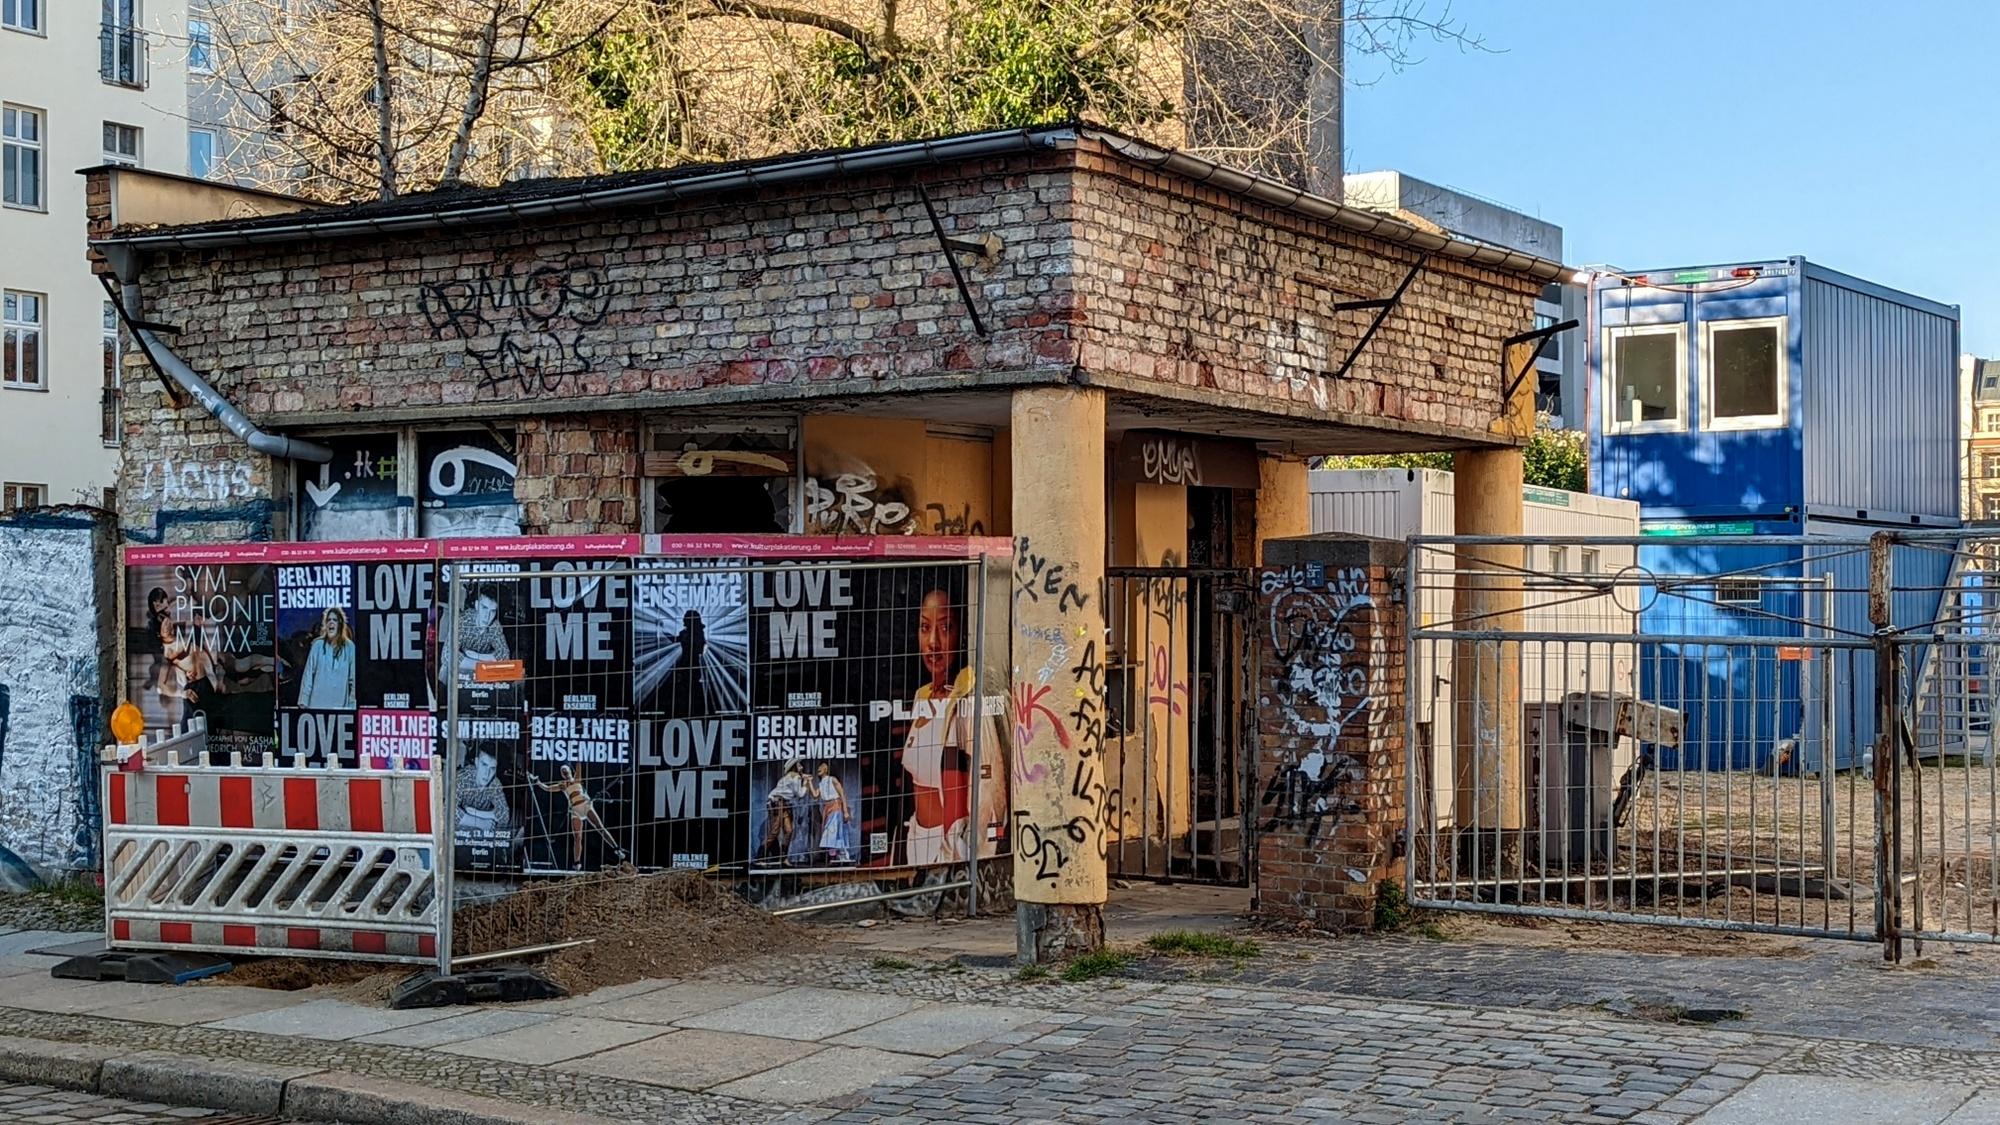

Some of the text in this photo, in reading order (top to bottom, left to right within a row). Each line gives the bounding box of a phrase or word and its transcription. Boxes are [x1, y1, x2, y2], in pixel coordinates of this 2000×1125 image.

[495, 542, 575, 551] www.kulturplakatierung.de
[731, 542, 821, 552] www.kulturplakatierung.de
[174, 565, 242, 593] SYM-
[278, 565, 351, 587] BERLINER
[441, 563, 520, 582] SM FENDER
[638, 562, 742, 584] BERLINER
[358, 563, 434, 610] LOVE
[530, 561, 628, 608] LOVE
[752, 561, 854, 607] LOVE
[279, 587, 351, 609] ENSEMBLE
[638, 585, 742, 607] ENSEMBLE
[176, 594, 274, 623] PHONIE
[175, 625, 252, 653] MMXX
[370, 613, 423, 660] ME
[546, 612, 614, 660] ME
[769, 611, 839, 659] ME
[384, 692, 410, 700] BERLINER
[384, 700, 410, 708] ENSEMBLE
[471, 690, 489, 698] Berlin
[563, 694, 597, 702] BERLINER
[788, 692, 822, 700] BERLINER
[788, 700, 822, 708] ENSEMBLE
[563, 702, 597, 710] ENSEMBLE
[869, 698, 949, 721] PLAY
[281, 713, 355, 759] LOVE
[362, 714, 438, 736] BERLINER
[441, 720, 520, 740] SM FENDER
[531, 716, 630, 740] BERLINER
[757, 714, 858, 737] BERLINER
[248, 735, 274, 745] SASHA
[362, 737, 438, 758] ENSEMBLE
[530, 739, 630, 763] ENSEMBLE
[639, 719, 747, 767] LOVE
[757, 738, 858, 760] ENSEMBLE
[654, 770, 729, 819] ME
[495, 830, 511, 839] 2022
[471, 847, 489, 856] Berlin
[672, 853, 709, 862] BERLINER
[672, 861, 709, 869] ENSEMBLE
